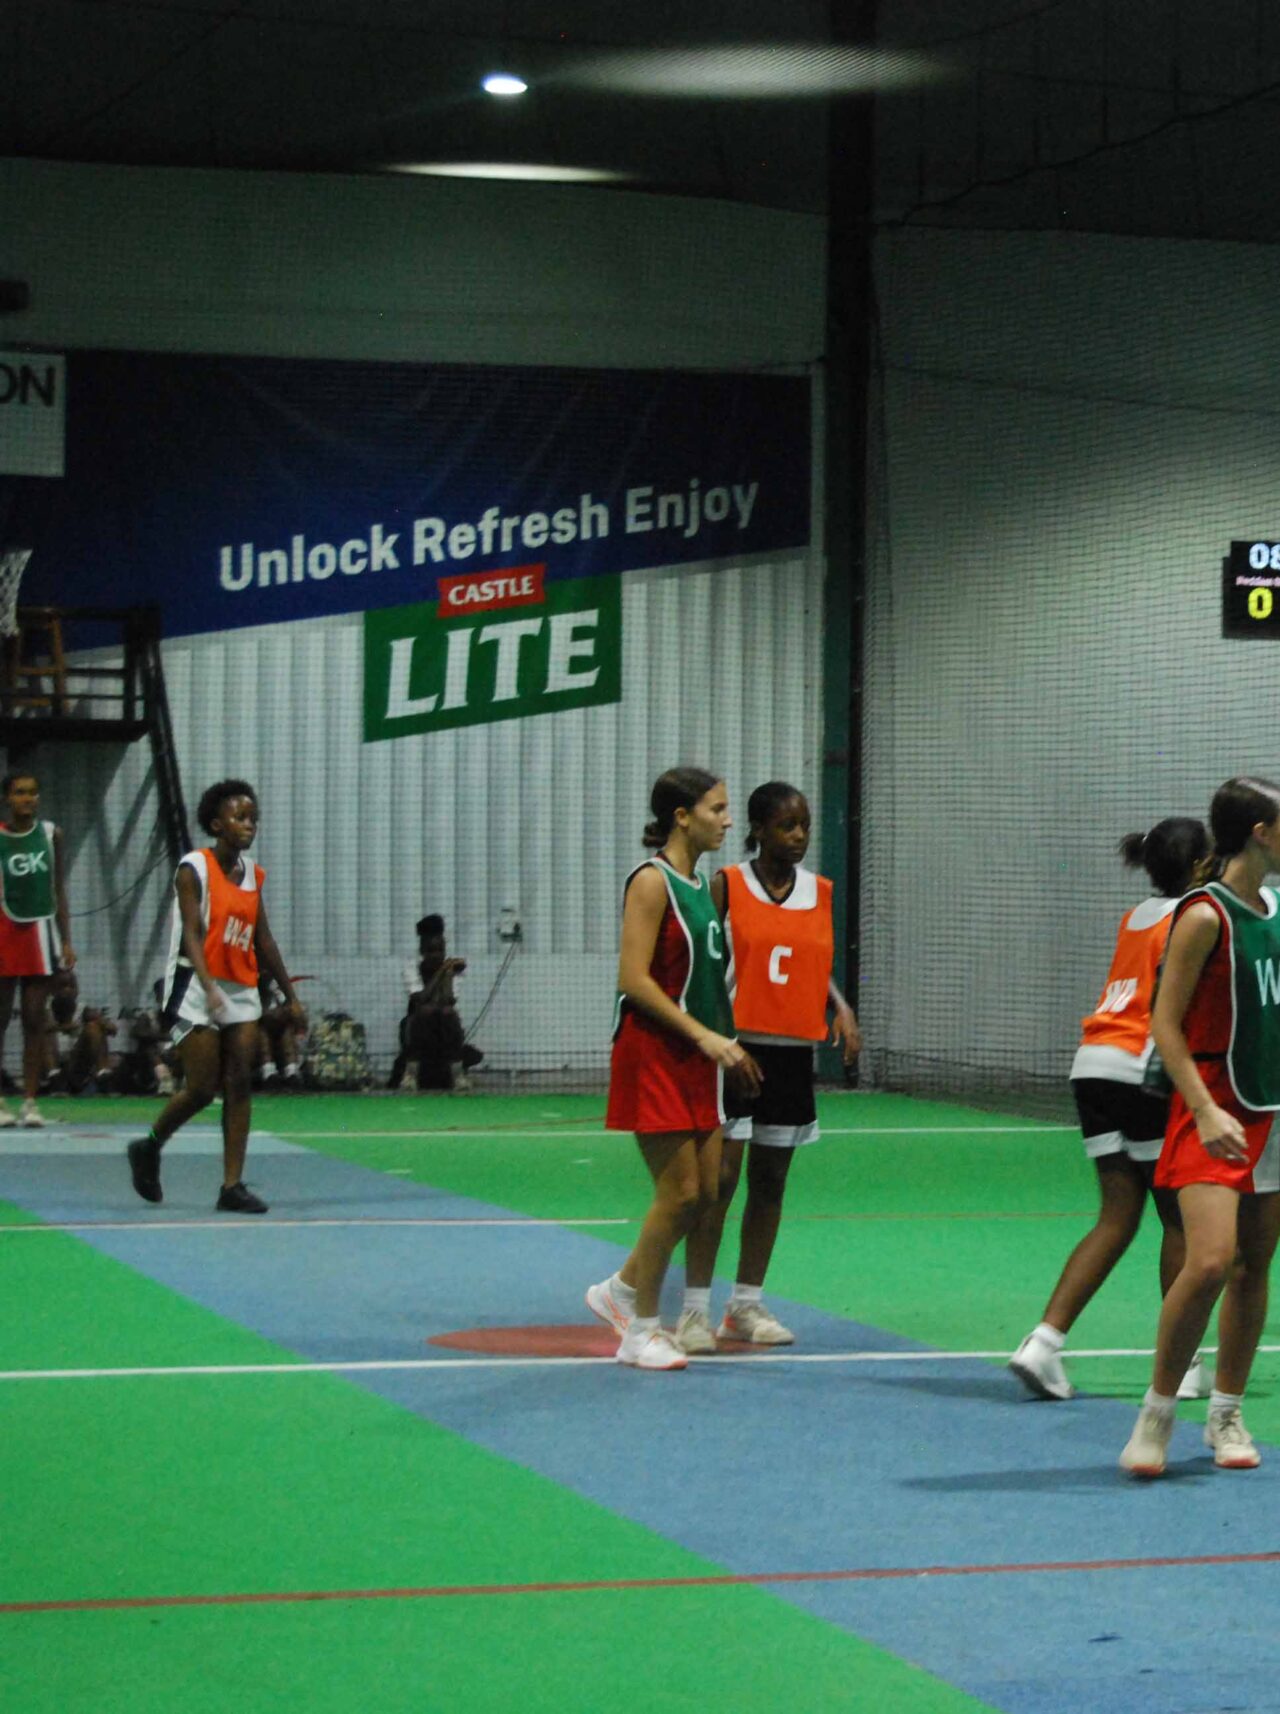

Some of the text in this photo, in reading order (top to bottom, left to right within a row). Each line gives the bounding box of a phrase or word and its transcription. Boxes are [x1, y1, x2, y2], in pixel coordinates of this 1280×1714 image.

[219, 478, 760, 592] Unlock Refresh Enjoy
[447, 575, 536, 606] CASTLE
[1248, 586, 1273, 619] 0
[384, 608, 601, 721] LITE
[7, 850, 50, 877] GK
[708, 920, 722, 960] C
[769, 945, 793, 985] C
